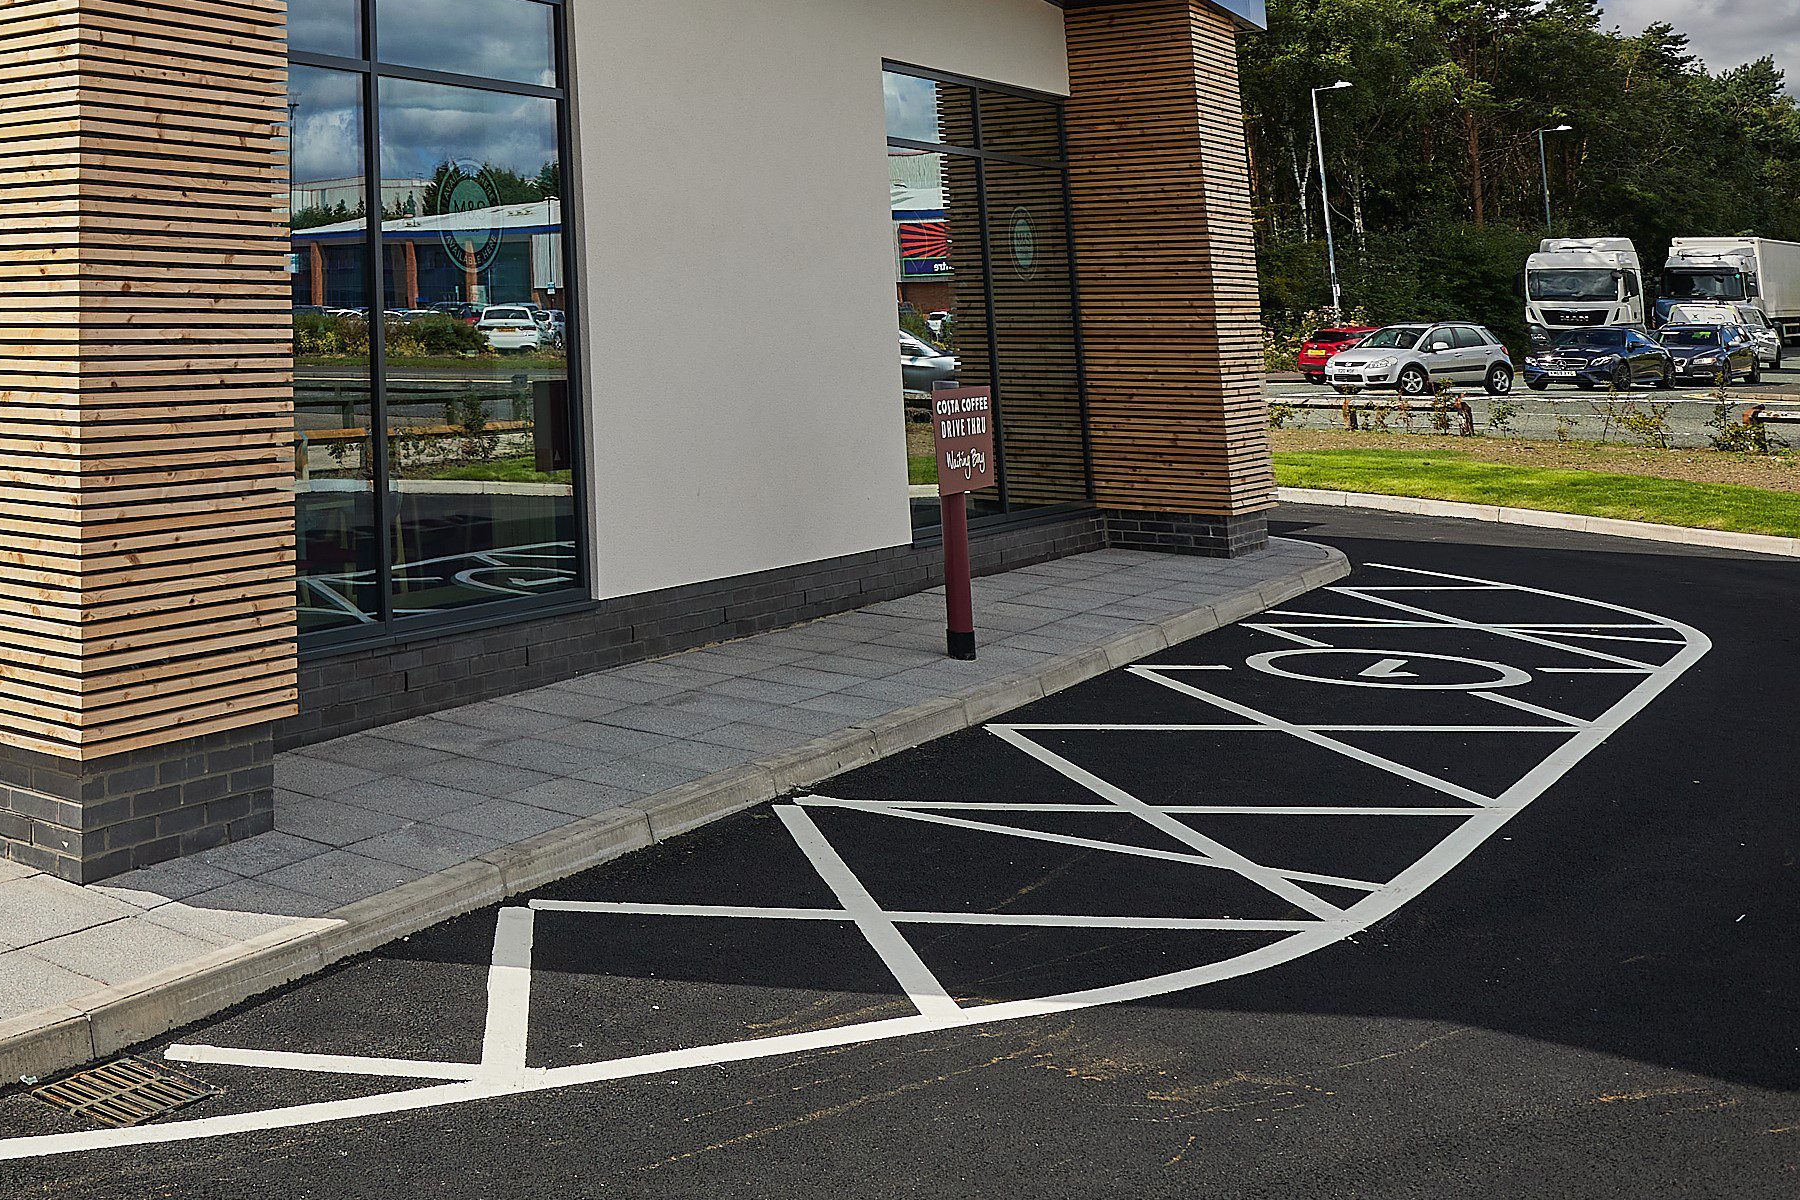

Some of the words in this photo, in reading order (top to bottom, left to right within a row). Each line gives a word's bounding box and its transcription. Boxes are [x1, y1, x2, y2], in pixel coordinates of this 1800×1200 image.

[453, 199, 487, 220] M&S
[444, 235, 482, 265] AVAILABLE
[482, 234, 498, 259] HERE
[936, 399, 959, 416] COSTA
[961, 396, 988, 413] COFFEE
[941, 418, 966, 439] DRIVE
[966, 416, 986, 435] THRU
[946, 449, 971, 479] Waiting
[970, 448, 985, 473] Bay
